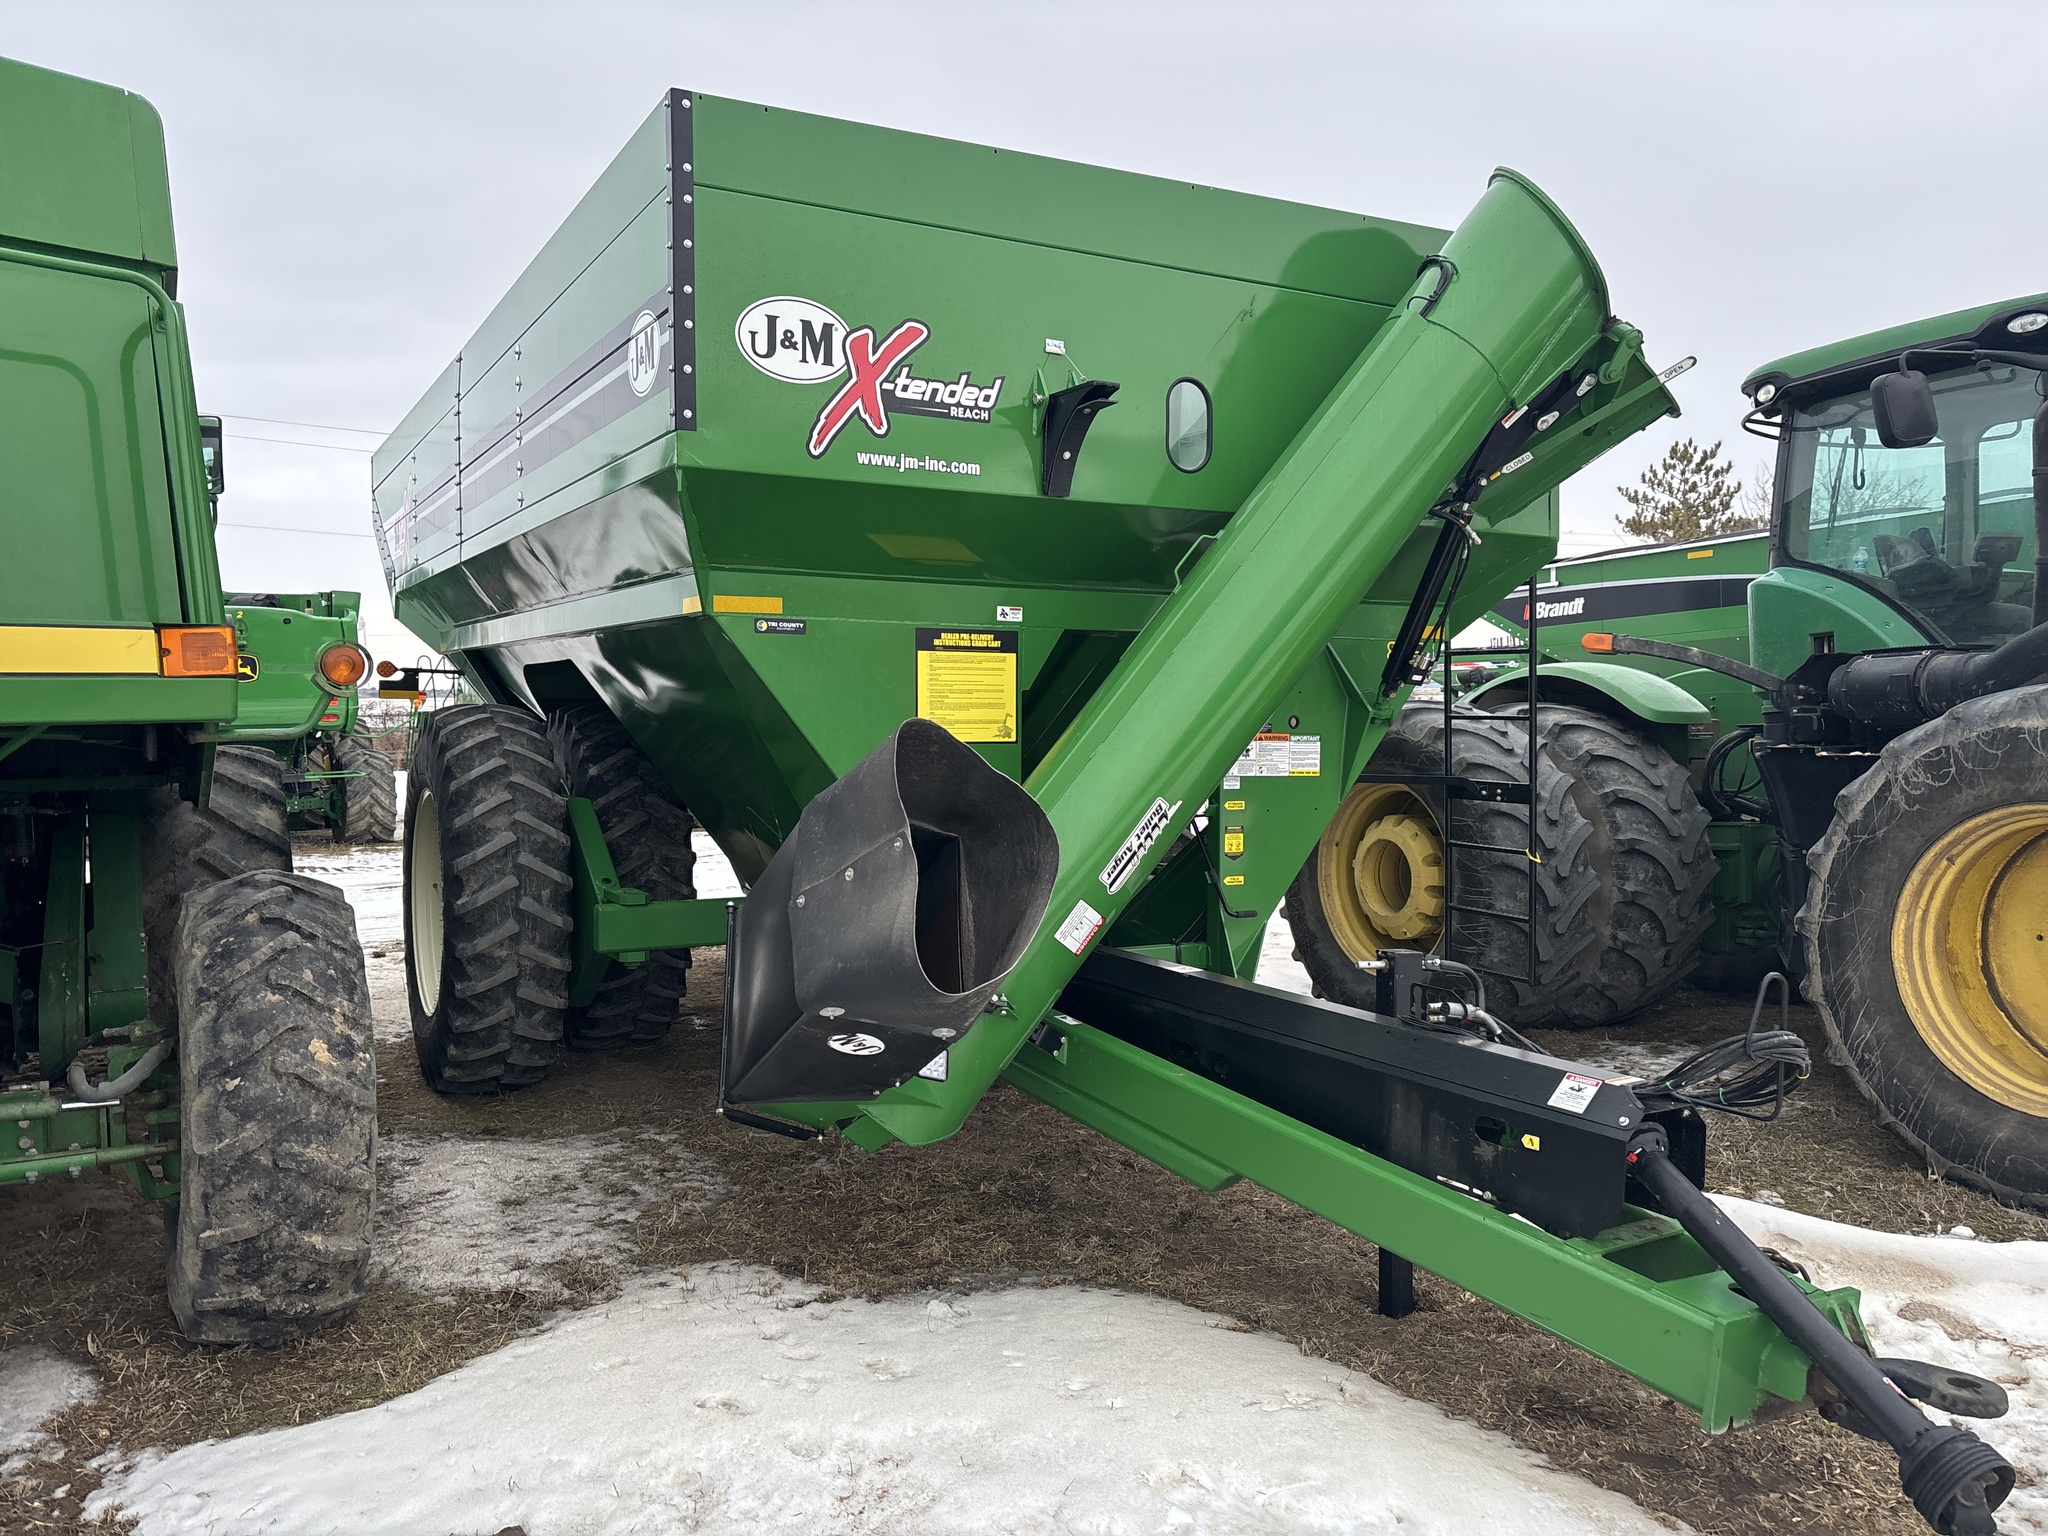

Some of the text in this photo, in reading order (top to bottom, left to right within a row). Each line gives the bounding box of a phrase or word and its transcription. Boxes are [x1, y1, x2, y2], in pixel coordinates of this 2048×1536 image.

[748, 313, 836, 368] J&M
[631, 325, 656, 382] J&M
[1663, 363, 1685, 379] OPEN
[950, 406, 989, 421] REACH
[857, 452, 981, 476] www.jm-inc.com
[1504, 453, 1532, 473] CLOSED
[236, 611, 243, 619] 2
[1535, 596, 1585, 619] Brandt
[933, 638, 971, 647] INSTRUCTIONS
[941, 632, 960, 640] DEALER
[1106, 802, 1164, 881] Bullet Auger
[1076, 926, 1099, 955] DANGER
